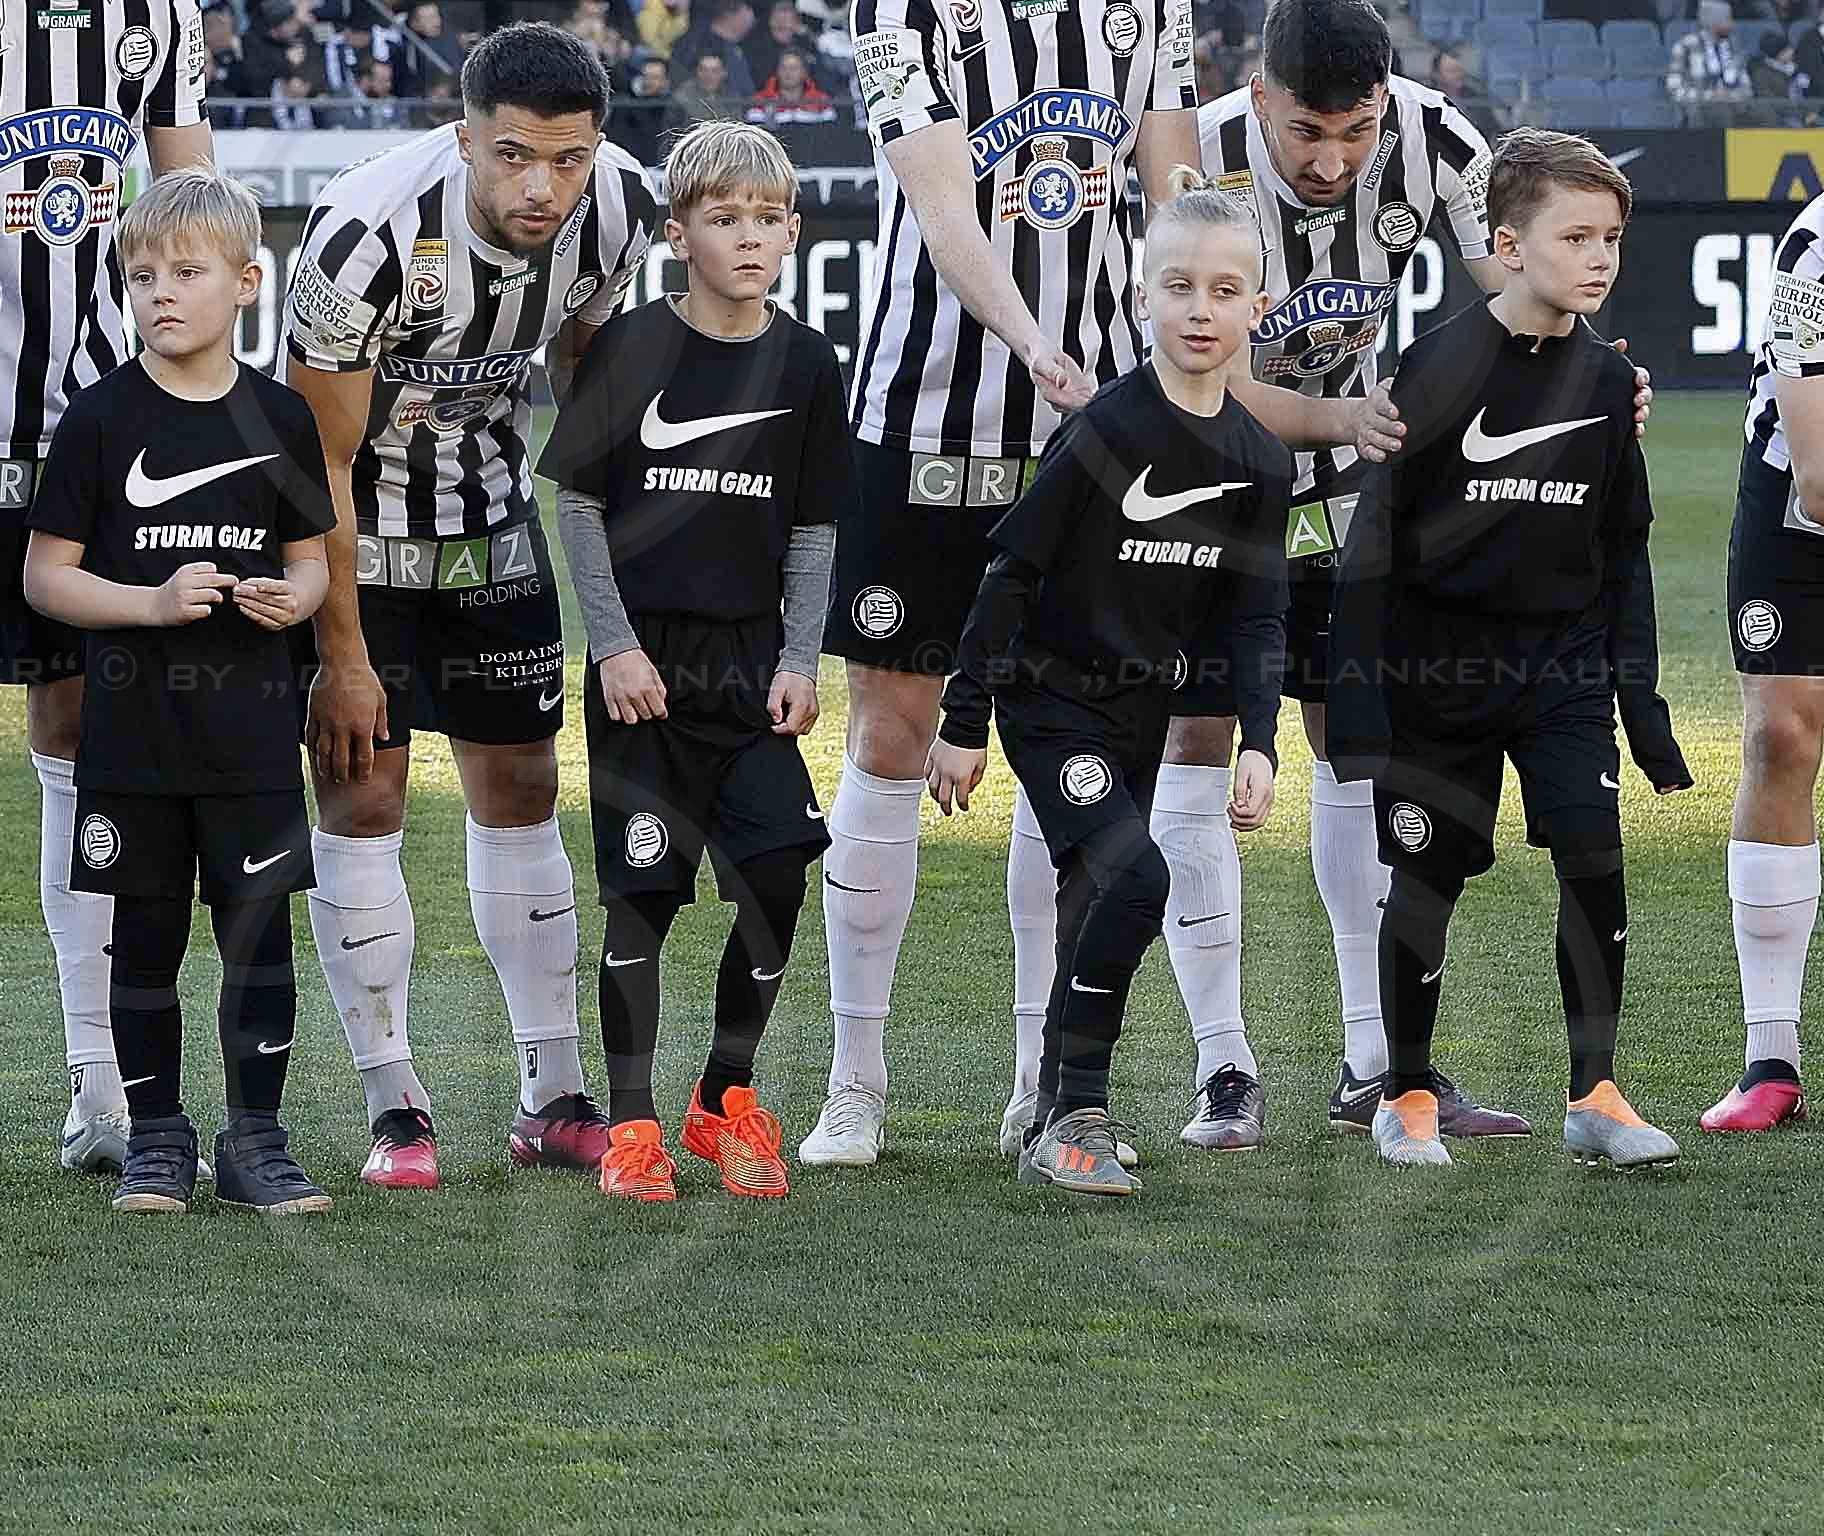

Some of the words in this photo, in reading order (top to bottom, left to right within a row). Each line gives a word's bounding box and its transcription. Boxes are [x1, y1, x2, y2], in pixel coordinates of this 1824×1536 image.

[50, 15, 91, 29] GRAWE
[1365, 133, 1397, 190] PUNTIGAMER
[1308, 209, 1346, 231] GRAWE
[416, 264, 437, 272] LIGA
[502, 271, 537, 293] GRAWE
[1256, 283, 1394, 339] UNTIGAM
[644, 467, 718, 492] STURM
[720, 471, 773, 498] GRAZ
[915, 460, 1006, 502] GR
[1465, 478, 1537, 504] STURM
[135, 525, 213, 549] STURM
[356, 531, 527, 584] GRAZ
[1118, 538, 1188, 567] STURM
[459, 578, 543, 609] HOLDING
[479, 640, 565, 664] DOMAINE
